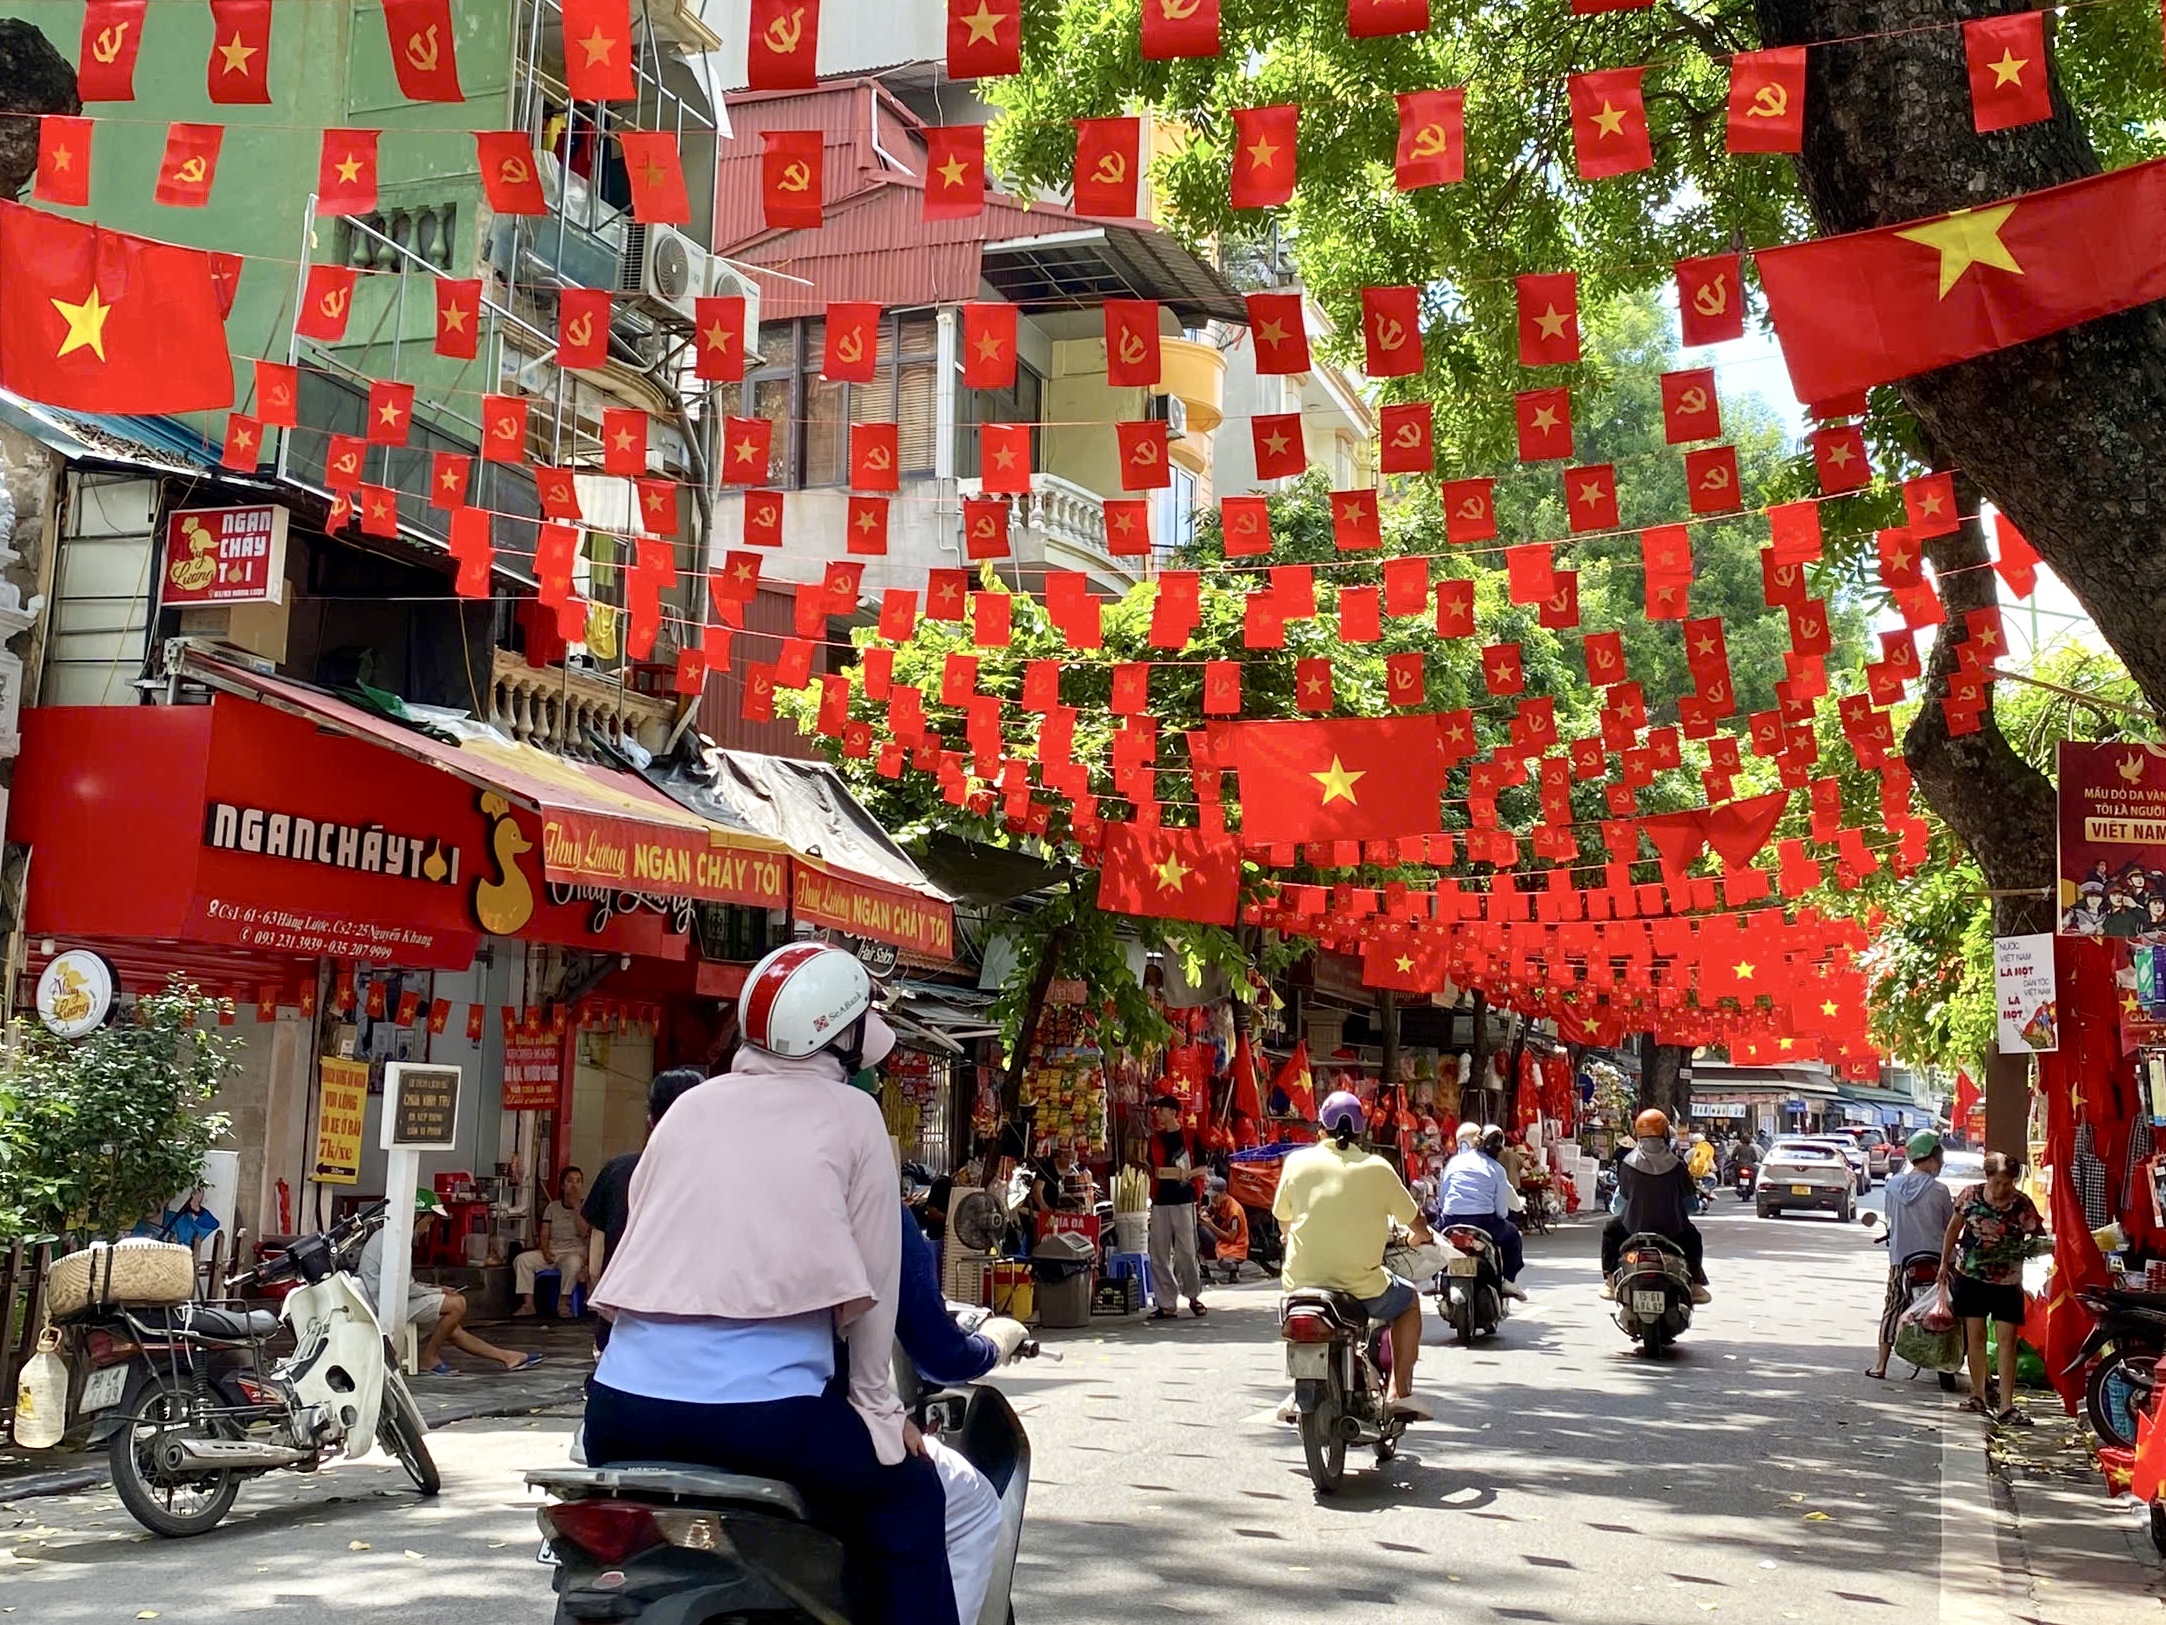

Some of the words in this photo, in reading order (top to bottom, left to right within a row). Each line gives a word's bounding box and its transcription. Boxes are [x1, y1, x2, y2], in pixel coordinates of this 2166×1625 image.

[222, 511, 271, 534] NGAN
[220, 532, 267, 559] CHÁY
[2129, 790, 2144, 801] DA
[2146, 789, 2166, 802] VÀN
[2095, 802, 2113, 815] TÔI
[2091, 820, 2128, 841] VIỆT
[2133, 823, 2166, 840] NAM
[633, 842, 691, 884] NGAN
[697, 849, 748, 891] CHÁY
[753, 853, 781, 896] TỎI
[853, 894, 891, 932] NGAN
[893, 903, 926, 942] CHÁY
[929, 908, 949, 947] TỎI
[254, 930, 275, 945] 093
[276, 933, 296, 948] 231
[318, 1137, 353, 1160] 7k/xe
